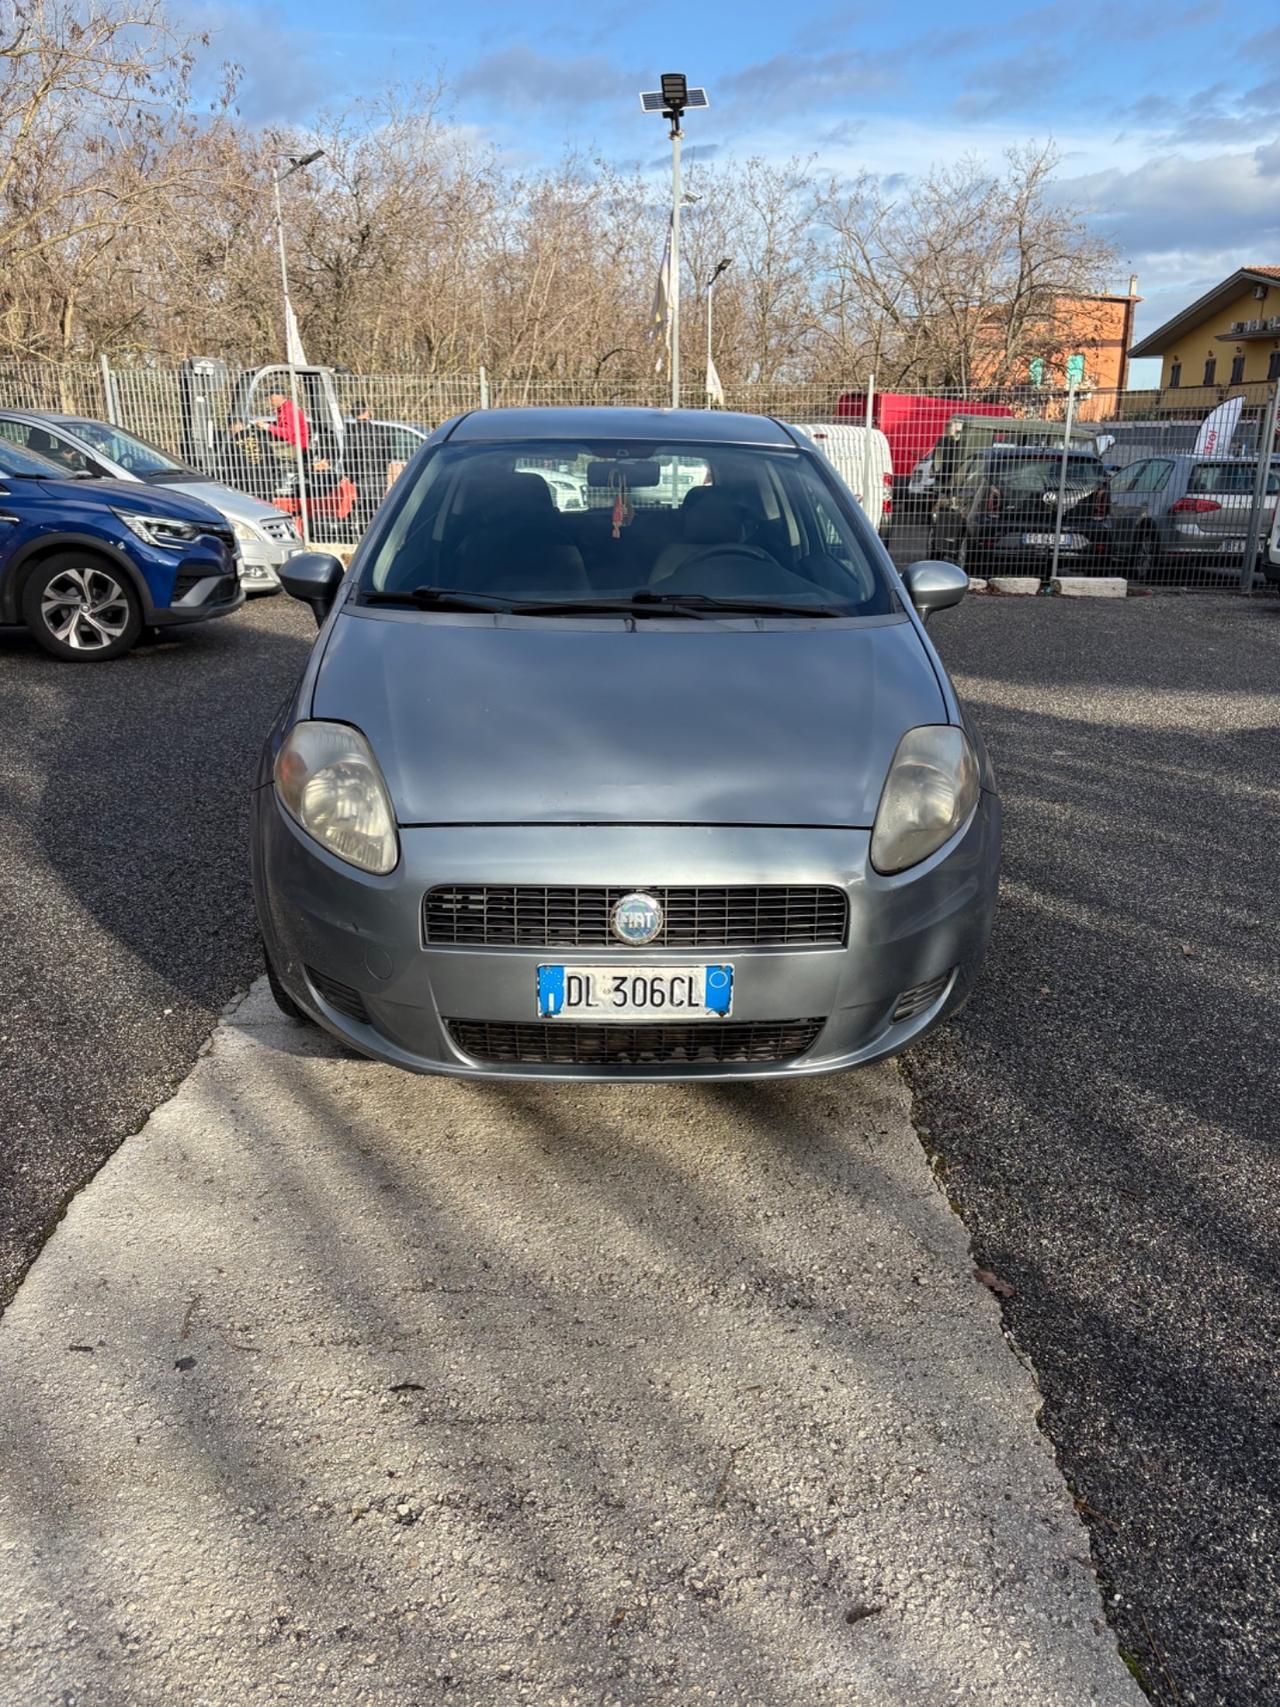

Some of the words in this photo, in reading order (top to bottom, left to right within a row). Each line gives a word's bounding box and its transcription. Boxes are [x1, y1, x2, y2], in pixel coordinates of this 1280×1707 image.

[620, 911, 654, 928] FIAT
[566, 975, 599, 1007] DL
[612, 976, 699, 1007] 306CL
